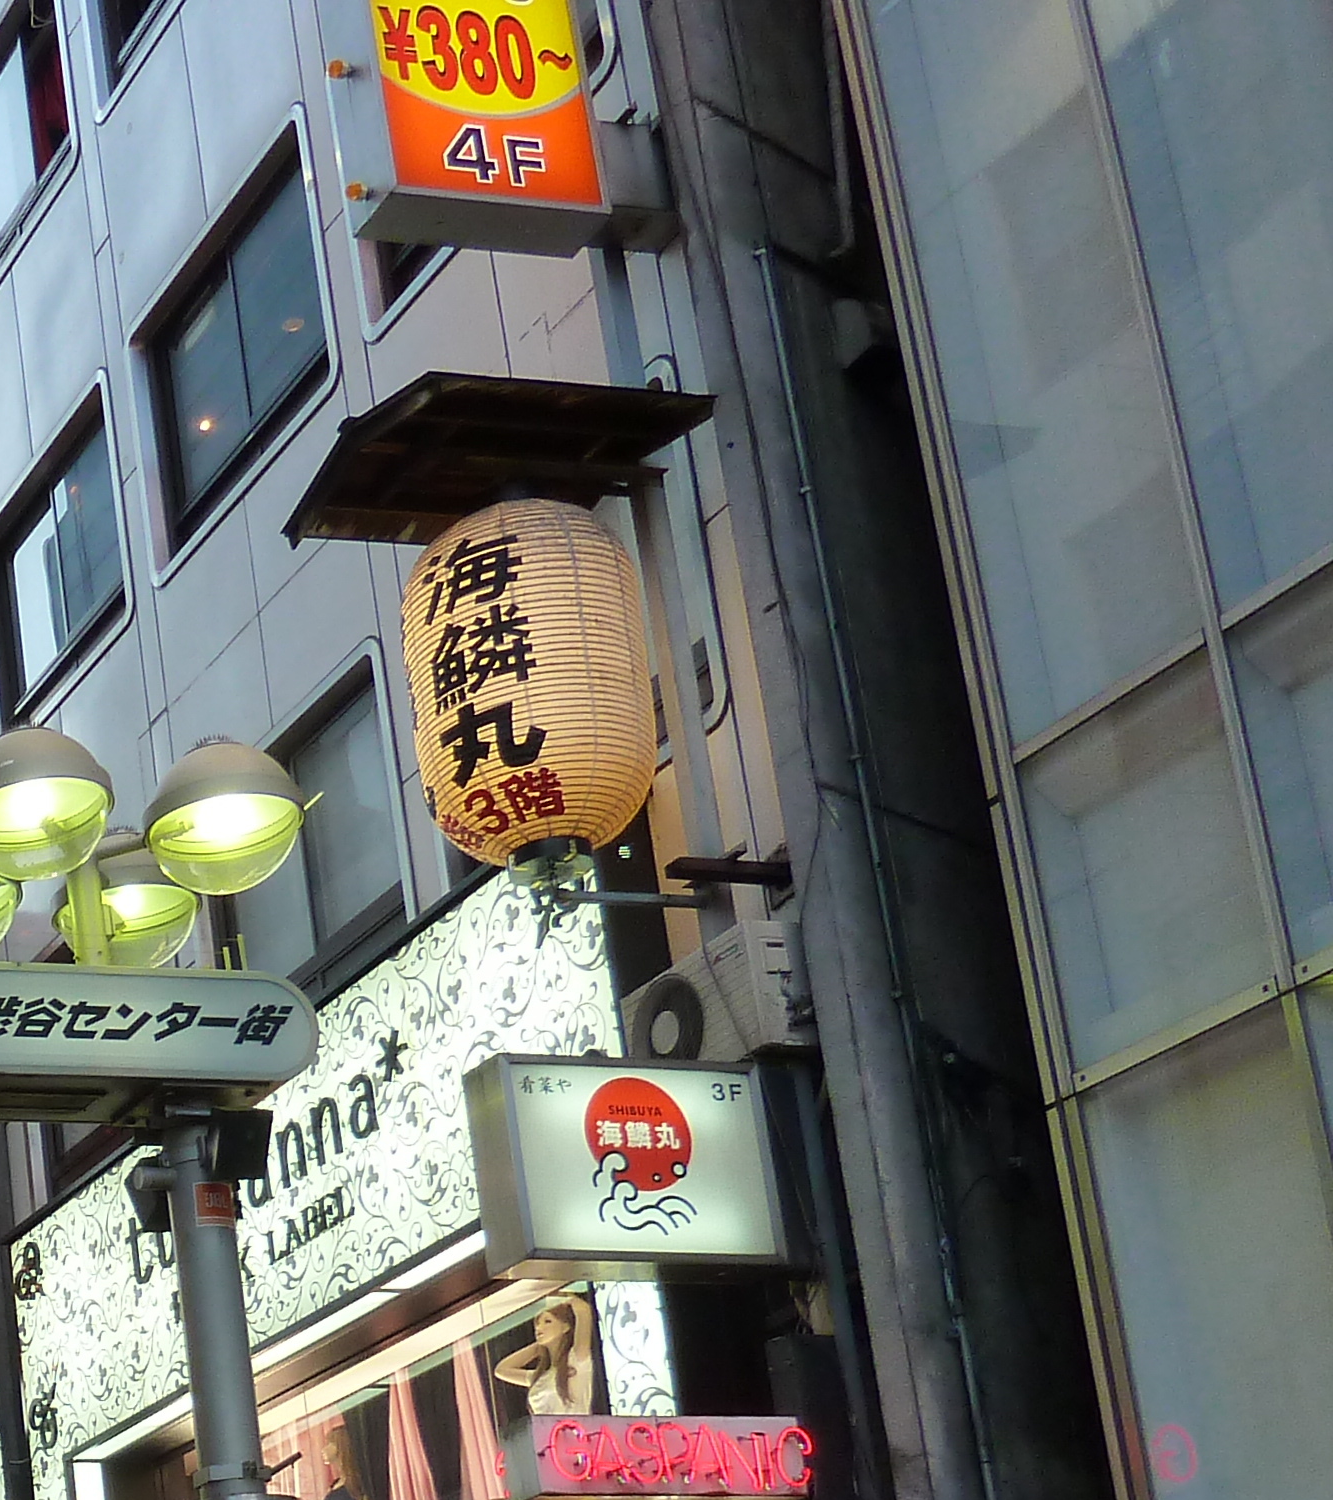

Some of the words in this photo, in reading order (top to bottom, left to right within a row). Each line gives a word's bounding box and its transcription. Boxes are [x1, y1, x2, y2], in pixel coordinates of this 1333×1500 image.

[443, 124, 546, 187] 4F
[422, 534, 548, 789] 海鱗丸
[465, 767, 566, 834] 3階
[607, 1104, 663, 1118] SHIBUYA
[710, 1082, 742, 1101] 3F
[596, 1120, 682, 1151] 海鱗丸
[266, 1186, 355, 1267] LABEL
[549, 1418, 814, 1492] GASPANIC
